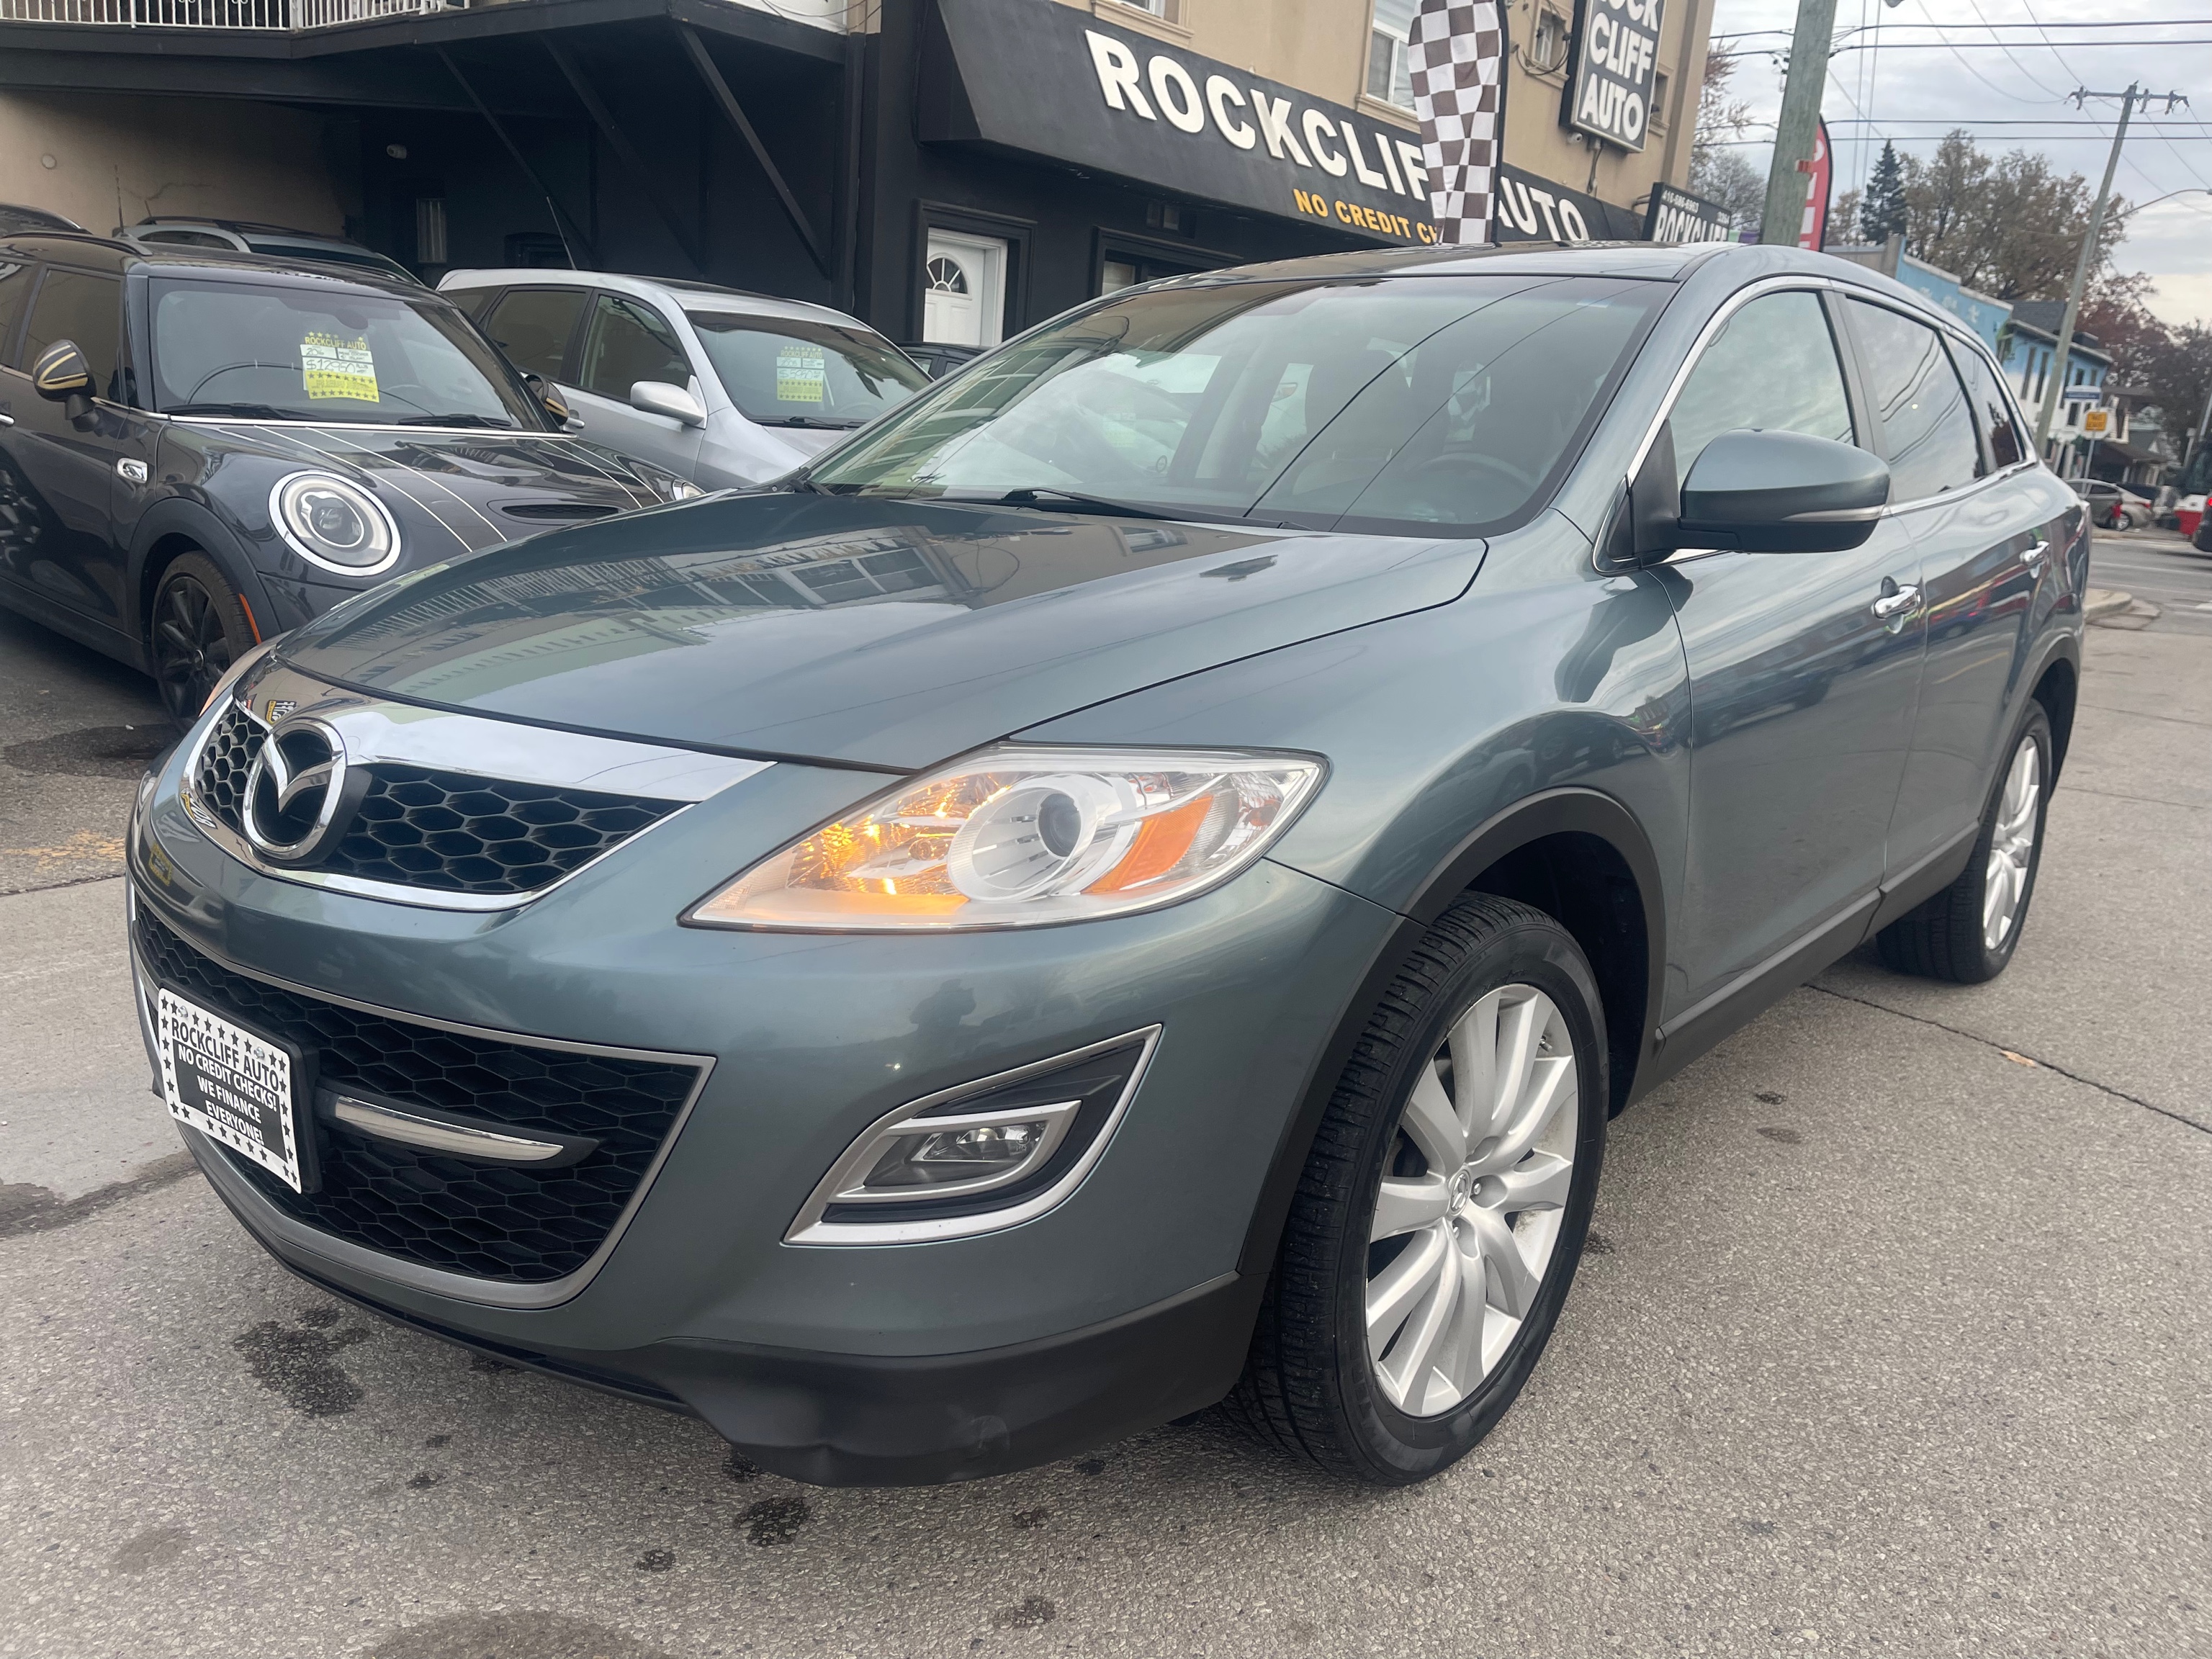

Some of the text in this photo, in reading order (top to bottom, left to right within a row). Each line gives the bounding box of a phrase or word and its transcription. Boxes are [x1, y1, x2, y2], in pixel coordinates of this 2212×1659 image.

[1589, 12, 1655, 85] CLIFF
[1084, 29, 1430, 202] ROCKCLIF
[1580, 73, 1645, 141] AUTO
[1293, 189, 1328, 217] NO
[1334, 200, 1410, 239] CREDIT
[305, 336, 367, 351] ROCKCLIFF AUTO
[171, 1017, 279, 1092] ROCKCLIFF AUTO
[177, 1043, 279, 1113] NO CREDIT CHECKS!
[197, 1075, 263, 1125] WE FINANCE
[204, 1100, 266, 1146] EVERYONE!
